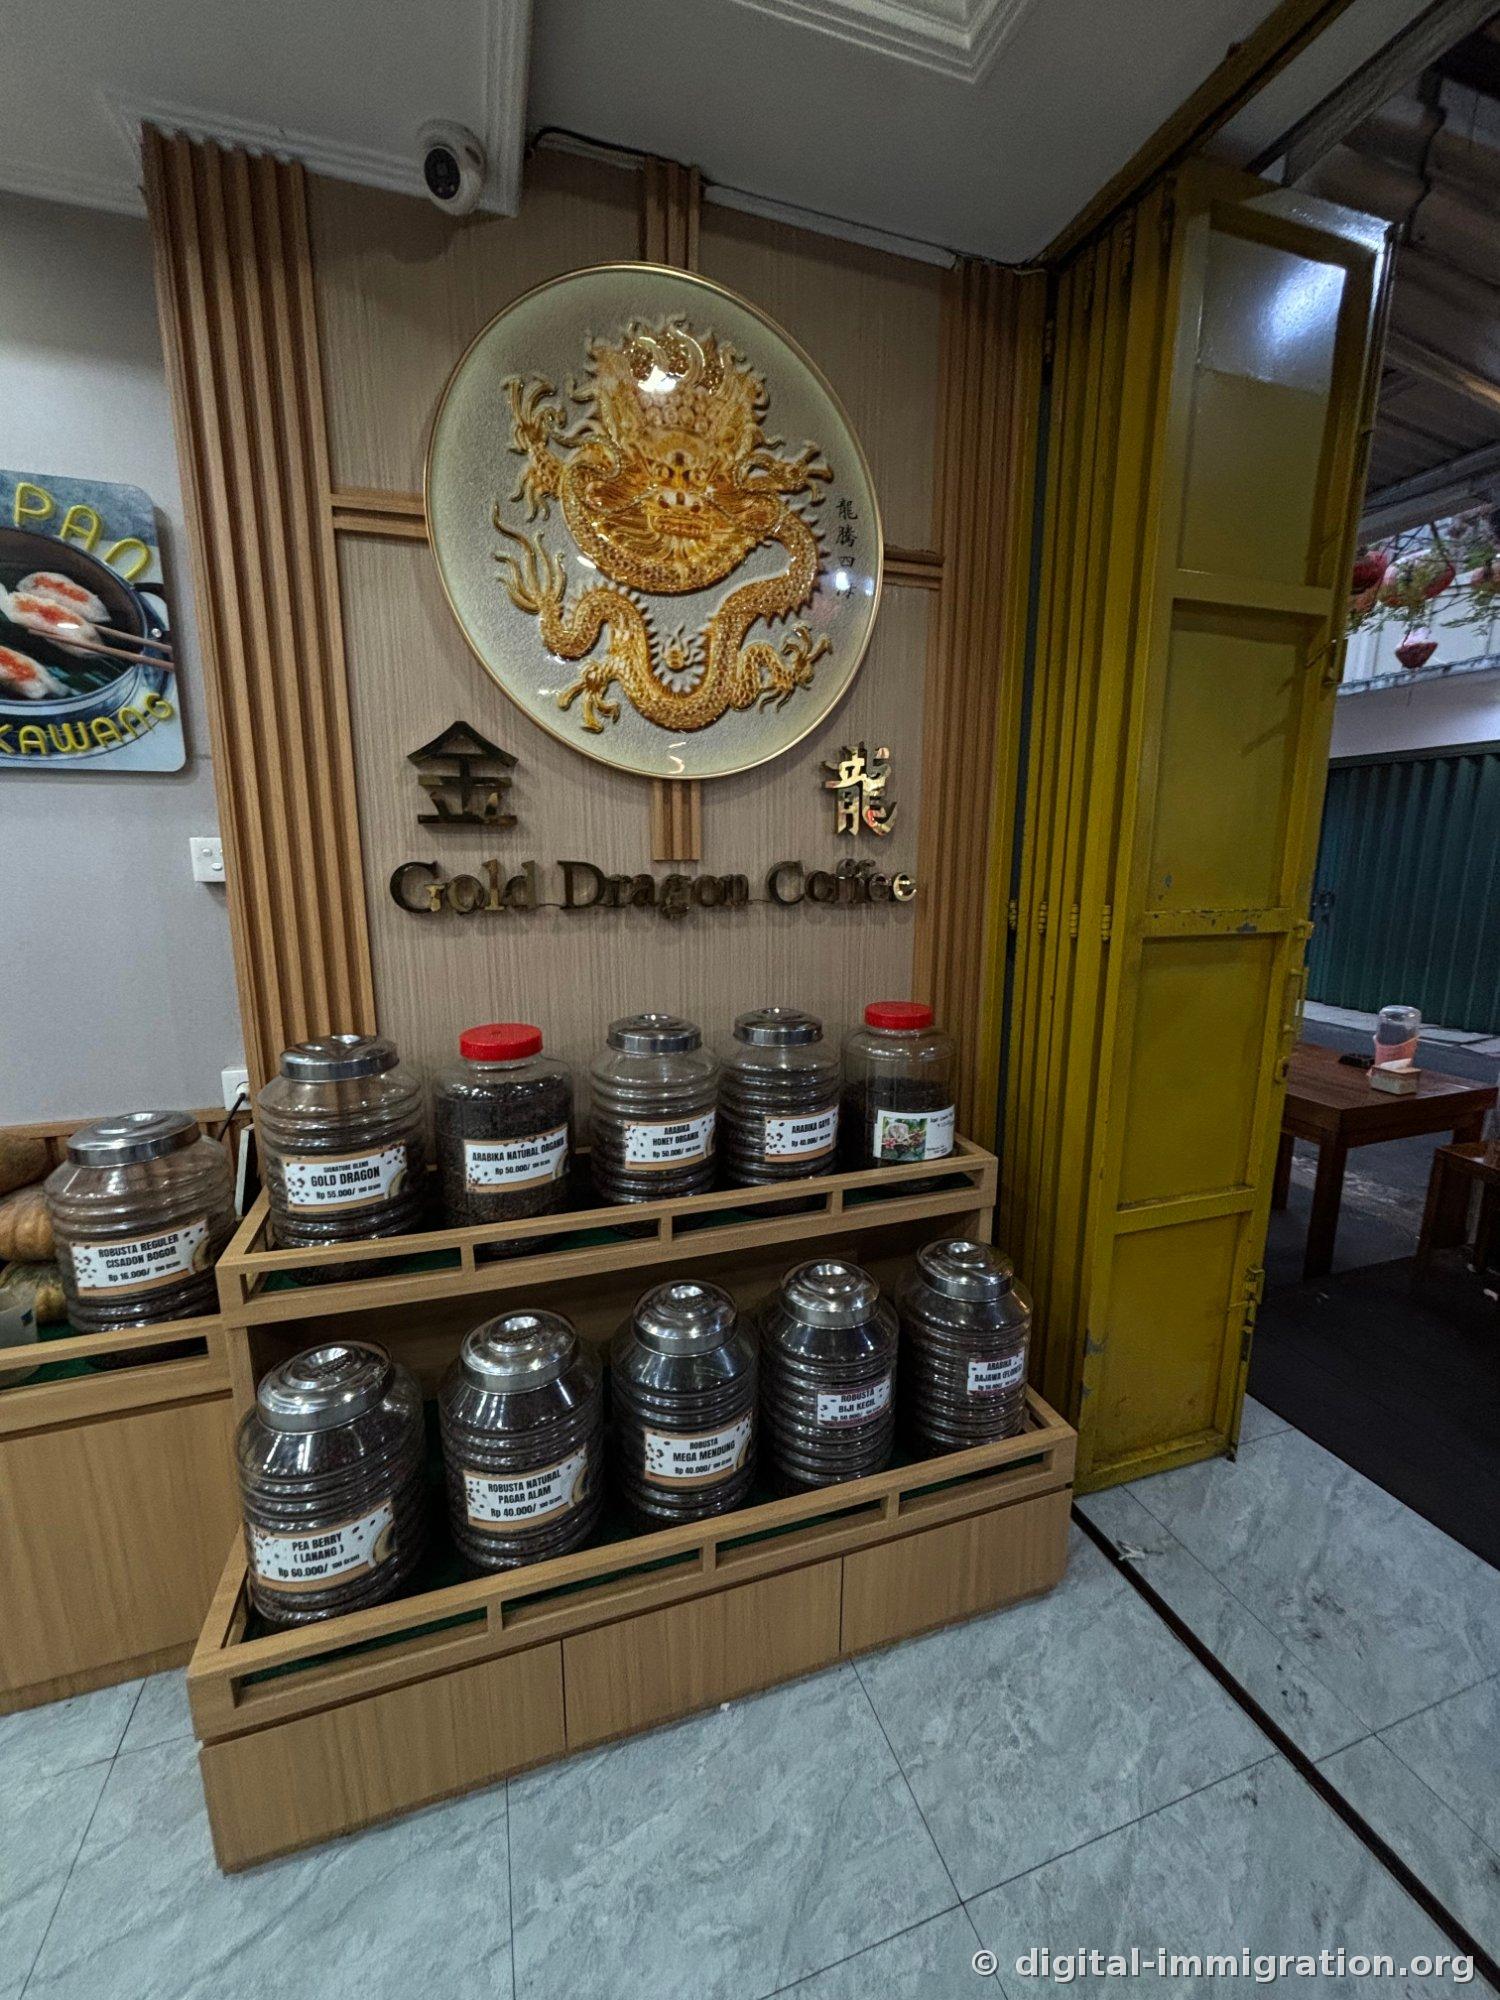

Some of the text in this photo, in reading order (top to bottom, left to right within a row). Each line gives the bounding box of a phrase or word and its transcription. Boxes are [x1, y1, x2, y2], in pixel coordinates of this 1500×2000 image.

[407, 721, 898, 837] 金 龍
[389, 858, 917, 920] Gold Dragon Coffee
[652, 1137, 673, 1146] HONEY
[472, 1152, 504, 1162] ARABIKA
[506, 1147, 539, 1160] NATURAL
[310, 1166, 380, 1187] GOLD DRAGON
[495, 1164, 530, 1176] Rp 50.000/
[316, 1191, 326, 1200] Rp
[98, 1234, 179, 1258] ROBUSTA REGULER
[106, 1246, 176, 1268] CISADON BOGOR
[108, 1274, 119, 1282] Rp
[840, 1388, 875, 1402] ROBUSTA
[838, 1404, 854, 1413] BIJI
[673, 1440, 736, 1462] MEGA MENDUNG
[690, 1438, 718, 1450] ROBUSTA
[488, 1470, 562, 1492] ROBUSTA NATURAL
[498, 1484, 552, 1504] PAGAR ALAM
[490, 1508, 500, 1518] Rp
[504, 1504, 536, 1517] 40.000/
[292, 1532, 342, 1552] PEA BERRY
[300, 1548, 338, 1563] LANANG
[278, 1567, 289, 1578] Rp
